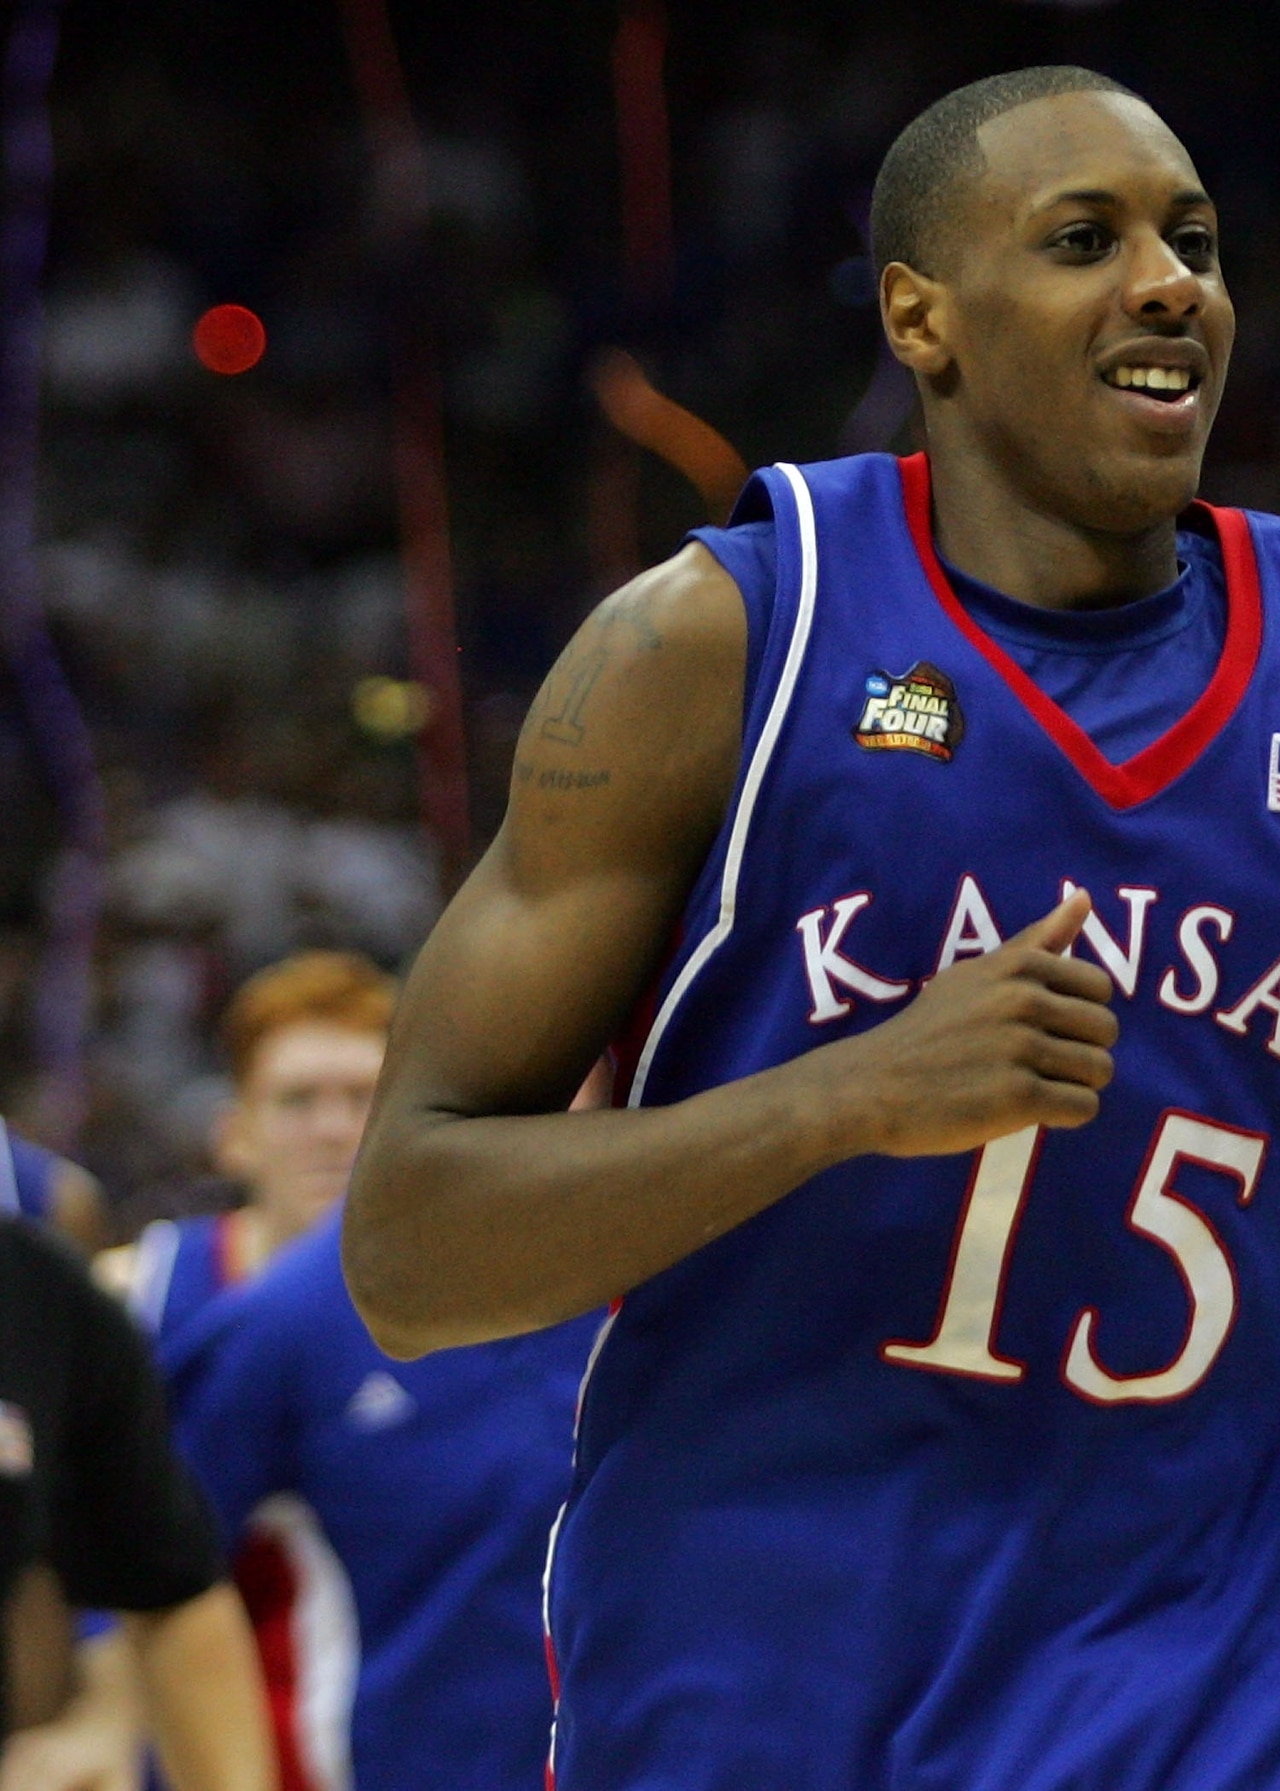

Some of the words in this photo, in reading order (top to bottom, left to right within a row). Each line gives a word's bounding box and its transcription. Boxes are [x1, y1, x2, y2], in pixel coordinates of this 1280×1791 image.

[858, 697, 950, 743] FOUR
[888, 685, 950, 717] FINAL
[880, 1107, 1271, 1407] 15
